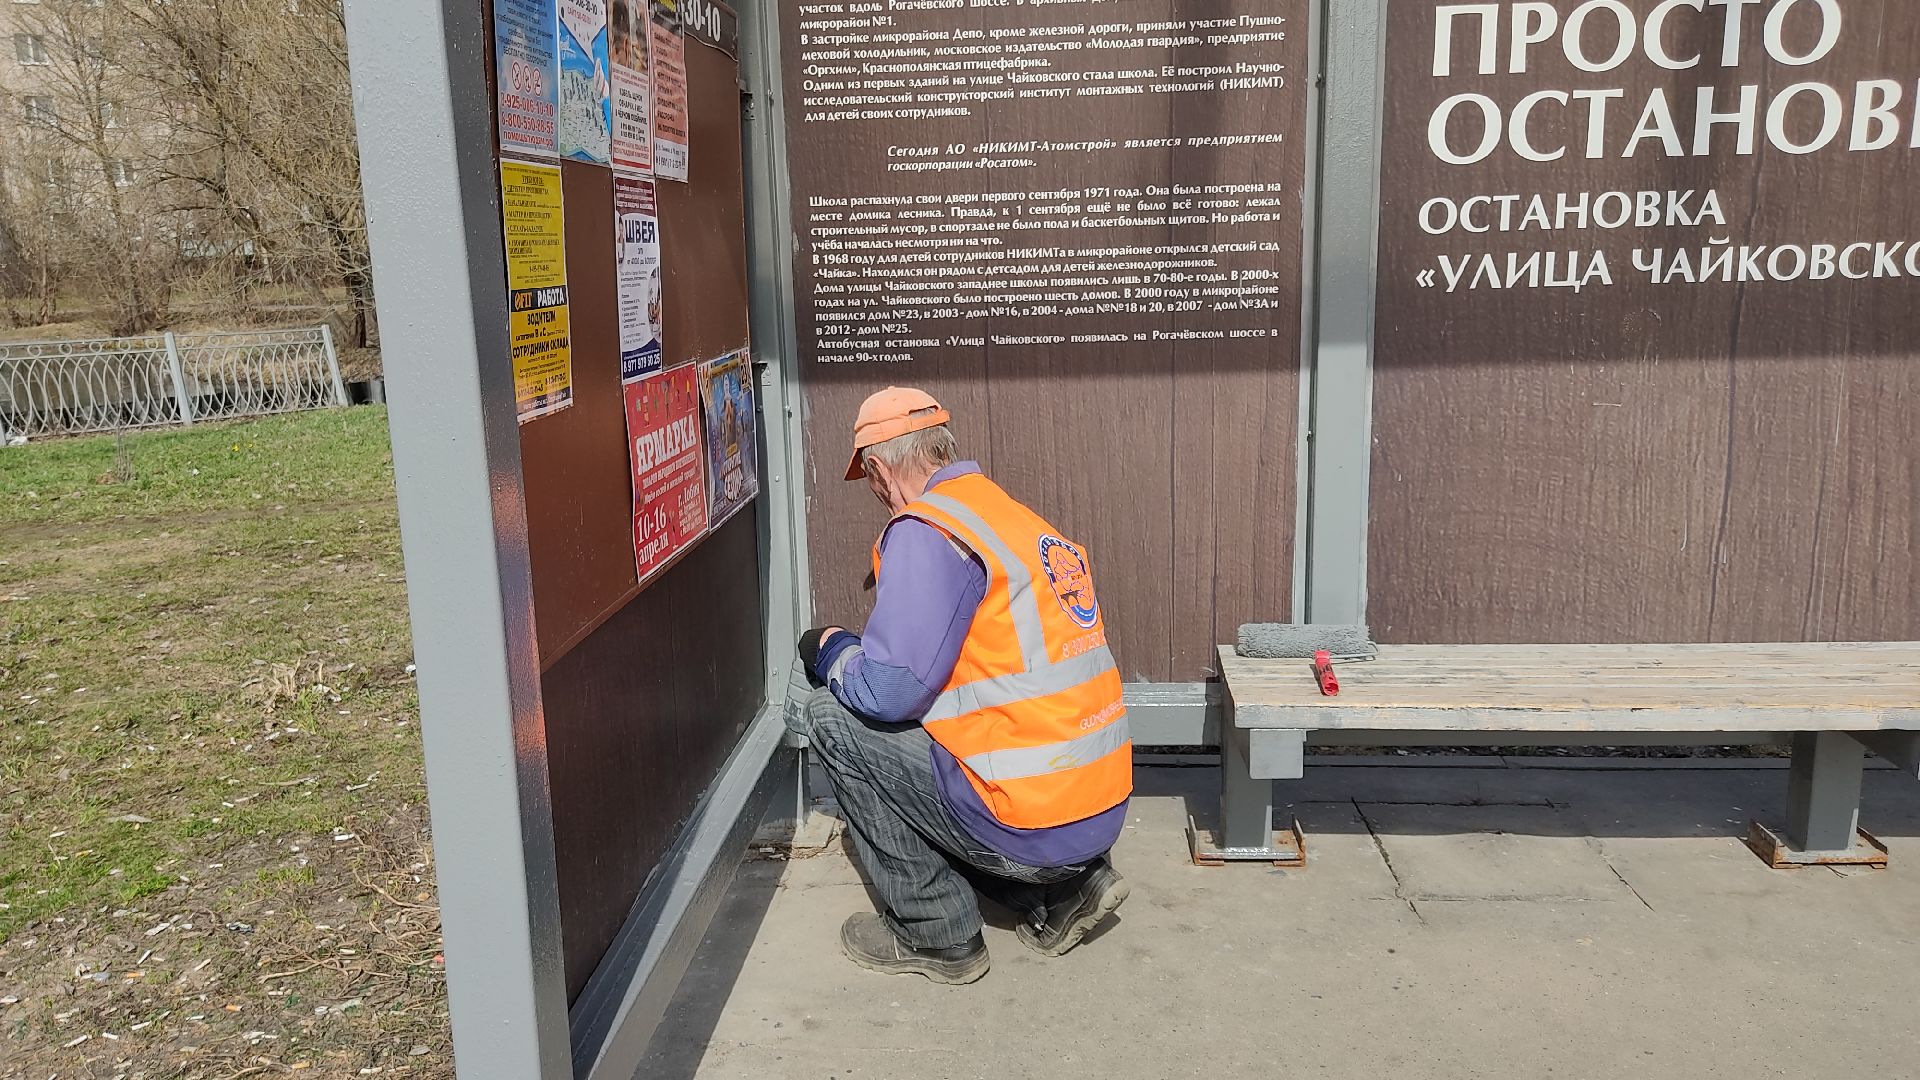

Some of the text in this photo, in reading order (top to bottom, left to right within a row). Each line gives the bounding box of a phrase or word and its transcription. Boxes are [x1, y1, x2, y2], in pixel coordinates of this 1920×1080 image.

[798, 3, 843, 16] участок
[849, 2, 882, 13] вдоль
[888, 0, 964, 10] Рогачёвского
[799, 15, 896, 31] микрорайон №1.
[811, 14, 1286, 46] застройке микрорайона Депо, кроме железной дороги, приняли участие Пушно-
[801, 31, 1285, 60] меховой холодильник, московское издательство «Молодая гвардия», предприятие
[1432, 0, 1842, 77] ПРОСТО
[802, 56, 1051, 77] «Оргхим», Краснополянская птицефабрика.
[803, 61, 1284, 92] Одним первых зданий улице Чайковского стала школа. построил Научно-
[803, 75, 1284, 107] исследовательский конструкторский институт монтажных технологий (НИКИМТ)
[826, 107, 971, 121] детей своих сотрудников.
[1428, 78, 1920, 165] ОСТАНОВ
[887, 133, 1282, 157] Сегодня «НИКИМТ-Атомстрой» является предприятием
[887, 157, 1036, 172] госкорпорации «Росатом».
[809, 183, 1264, 208] Школа распахнула свои двери первого сентября 1971 года. была построена
[809, 197, 1280, 222] месте домика лесника. Правда, сентября было готово: лежал
[1418, 189, 1727, 235] ОСТАНОВКА
[625, 219, 655, 243] ШВЕЯ
[810, 210, 1270, 238] строительный мусор, спортзале было пола баскетбольных щитов. работа
[811, 238, 948, 252] учёба началась несмотря
[822, 240, 1257, 265] 1968 году детей сотрудников НИКИМТа микрорайоне открылся детский
[813, 258, 1217, 278] «Чайка». Находился рядом детсадом детей железнодорожников.
[813, 266, 1279, 294] Дома улицы Чайковского западнее школы появились лишь 70-80-е годы. 2000-х
[1415, 250, 1613, 294] «УЛИЦА
[537, 287, 565, 308] РАБОТА
[814, 284, 1279, 308] годах Чайковского было построено шесть домов. 2000 году микрорайоне
[527, 310, 556, 326] ВОДИТЕЛИ
[815, 312, 866, 321] появился
[892, 309, 922, 320] №23,
[932, 307, 959, 318] 2003
[990, 306, 1021, 318] №16,
[1030, 305, 1057, 315] 2004
[1064, 306, 1094, 316] дома
[1175, 300, 1203, 311] 2007
[816, 329, 1265, 350] Автобусная остановка «Улица Чайковского» появилась Рогачёвском шоссе
[823, 323, 912, 335] 2012 №25.
[817, 352, 913, 362] начале 90-х годов.
[636, 414, 696, 476] ЯРМАРКА
[638, 502, 667, 545] 10-16
[639, 531, 669, 565] апреля
